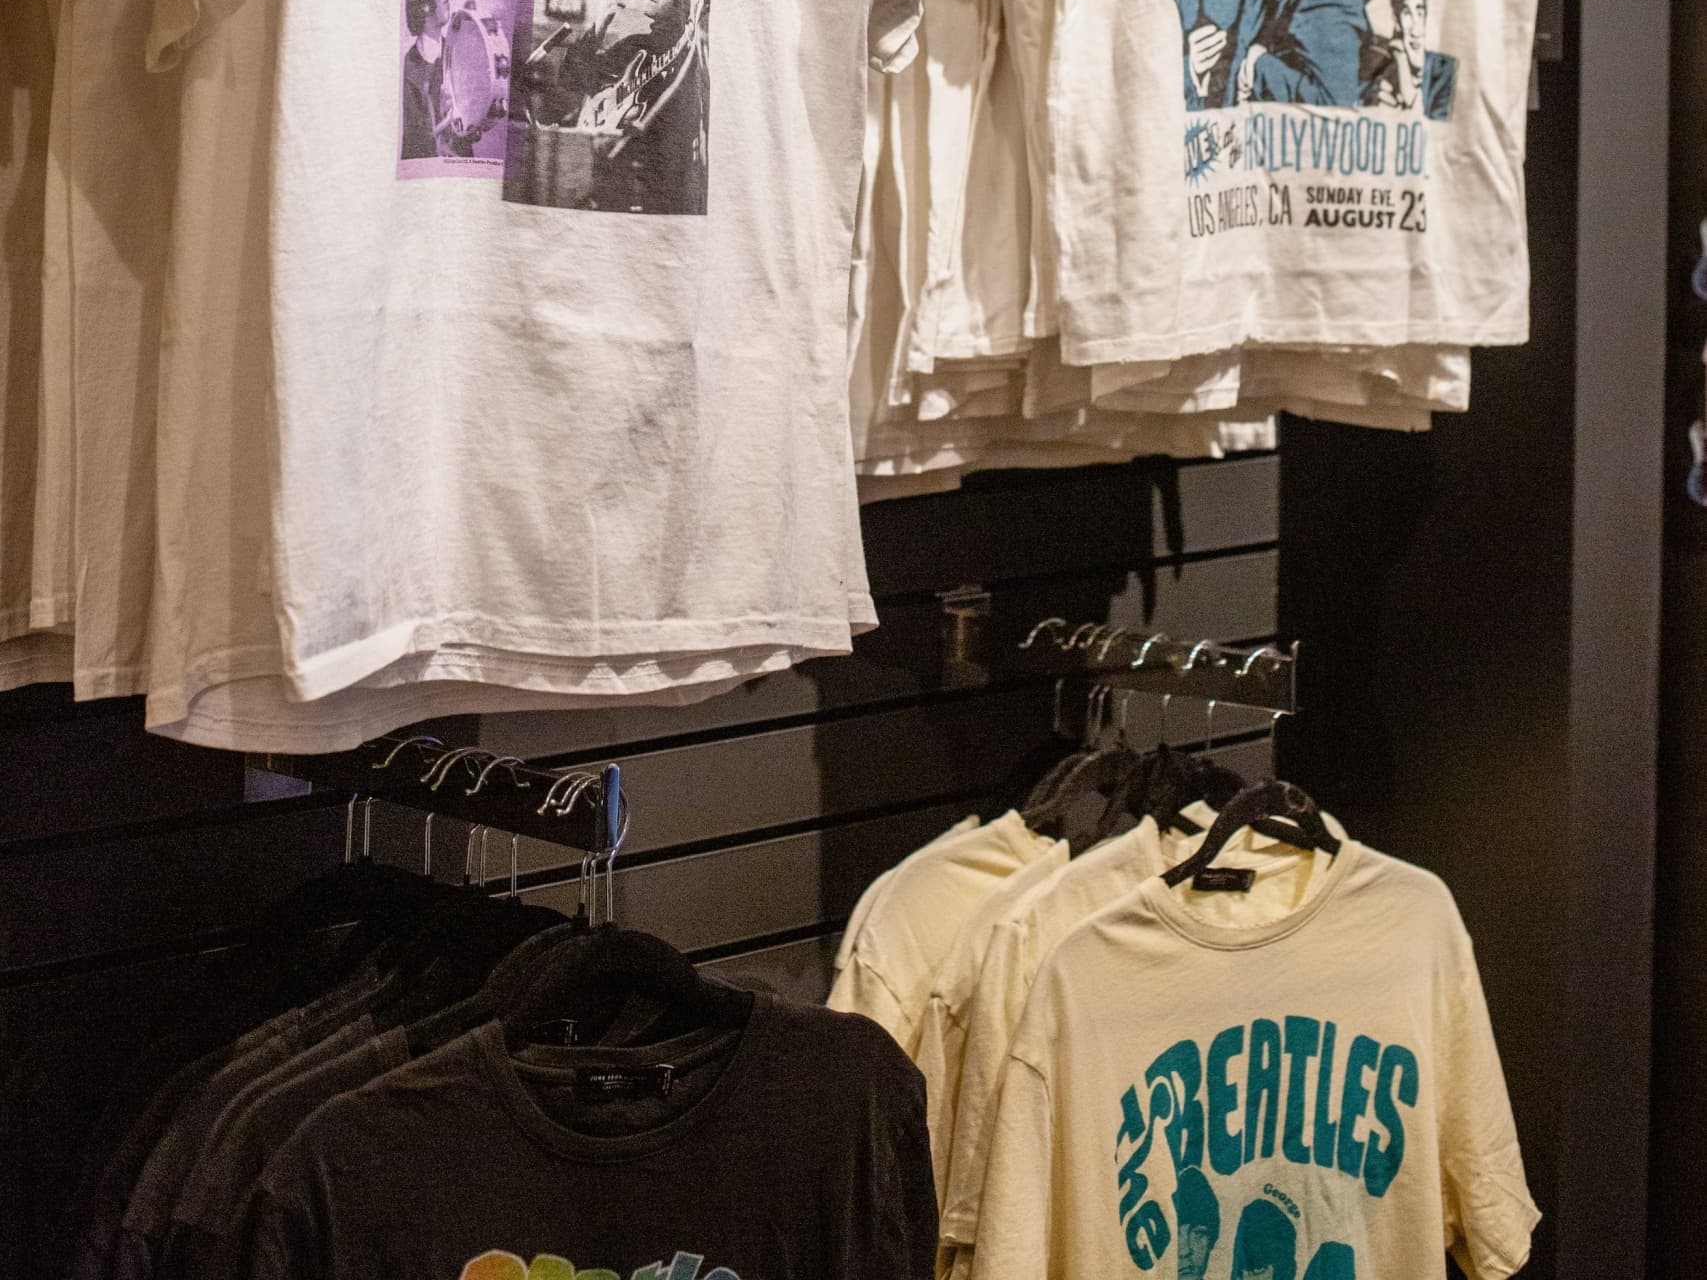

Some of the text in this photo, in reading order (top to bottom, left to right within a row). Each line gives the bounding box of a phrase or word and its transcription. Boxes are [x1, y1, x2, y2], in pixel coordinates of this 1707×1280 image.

[1244, 112, 1386, 176] HOLLYWOOD
[1395, 120, 1427, 178] BO
[1187, 193, 1215, 237] LOS
[1268, 183, 1292, 226] CA
[1304, 189, 1427, 233] AUGUST 23
[1306, 186, 1363, 206] SUNDAY
[1144, 1015, 1420, 1199] BEATLES
